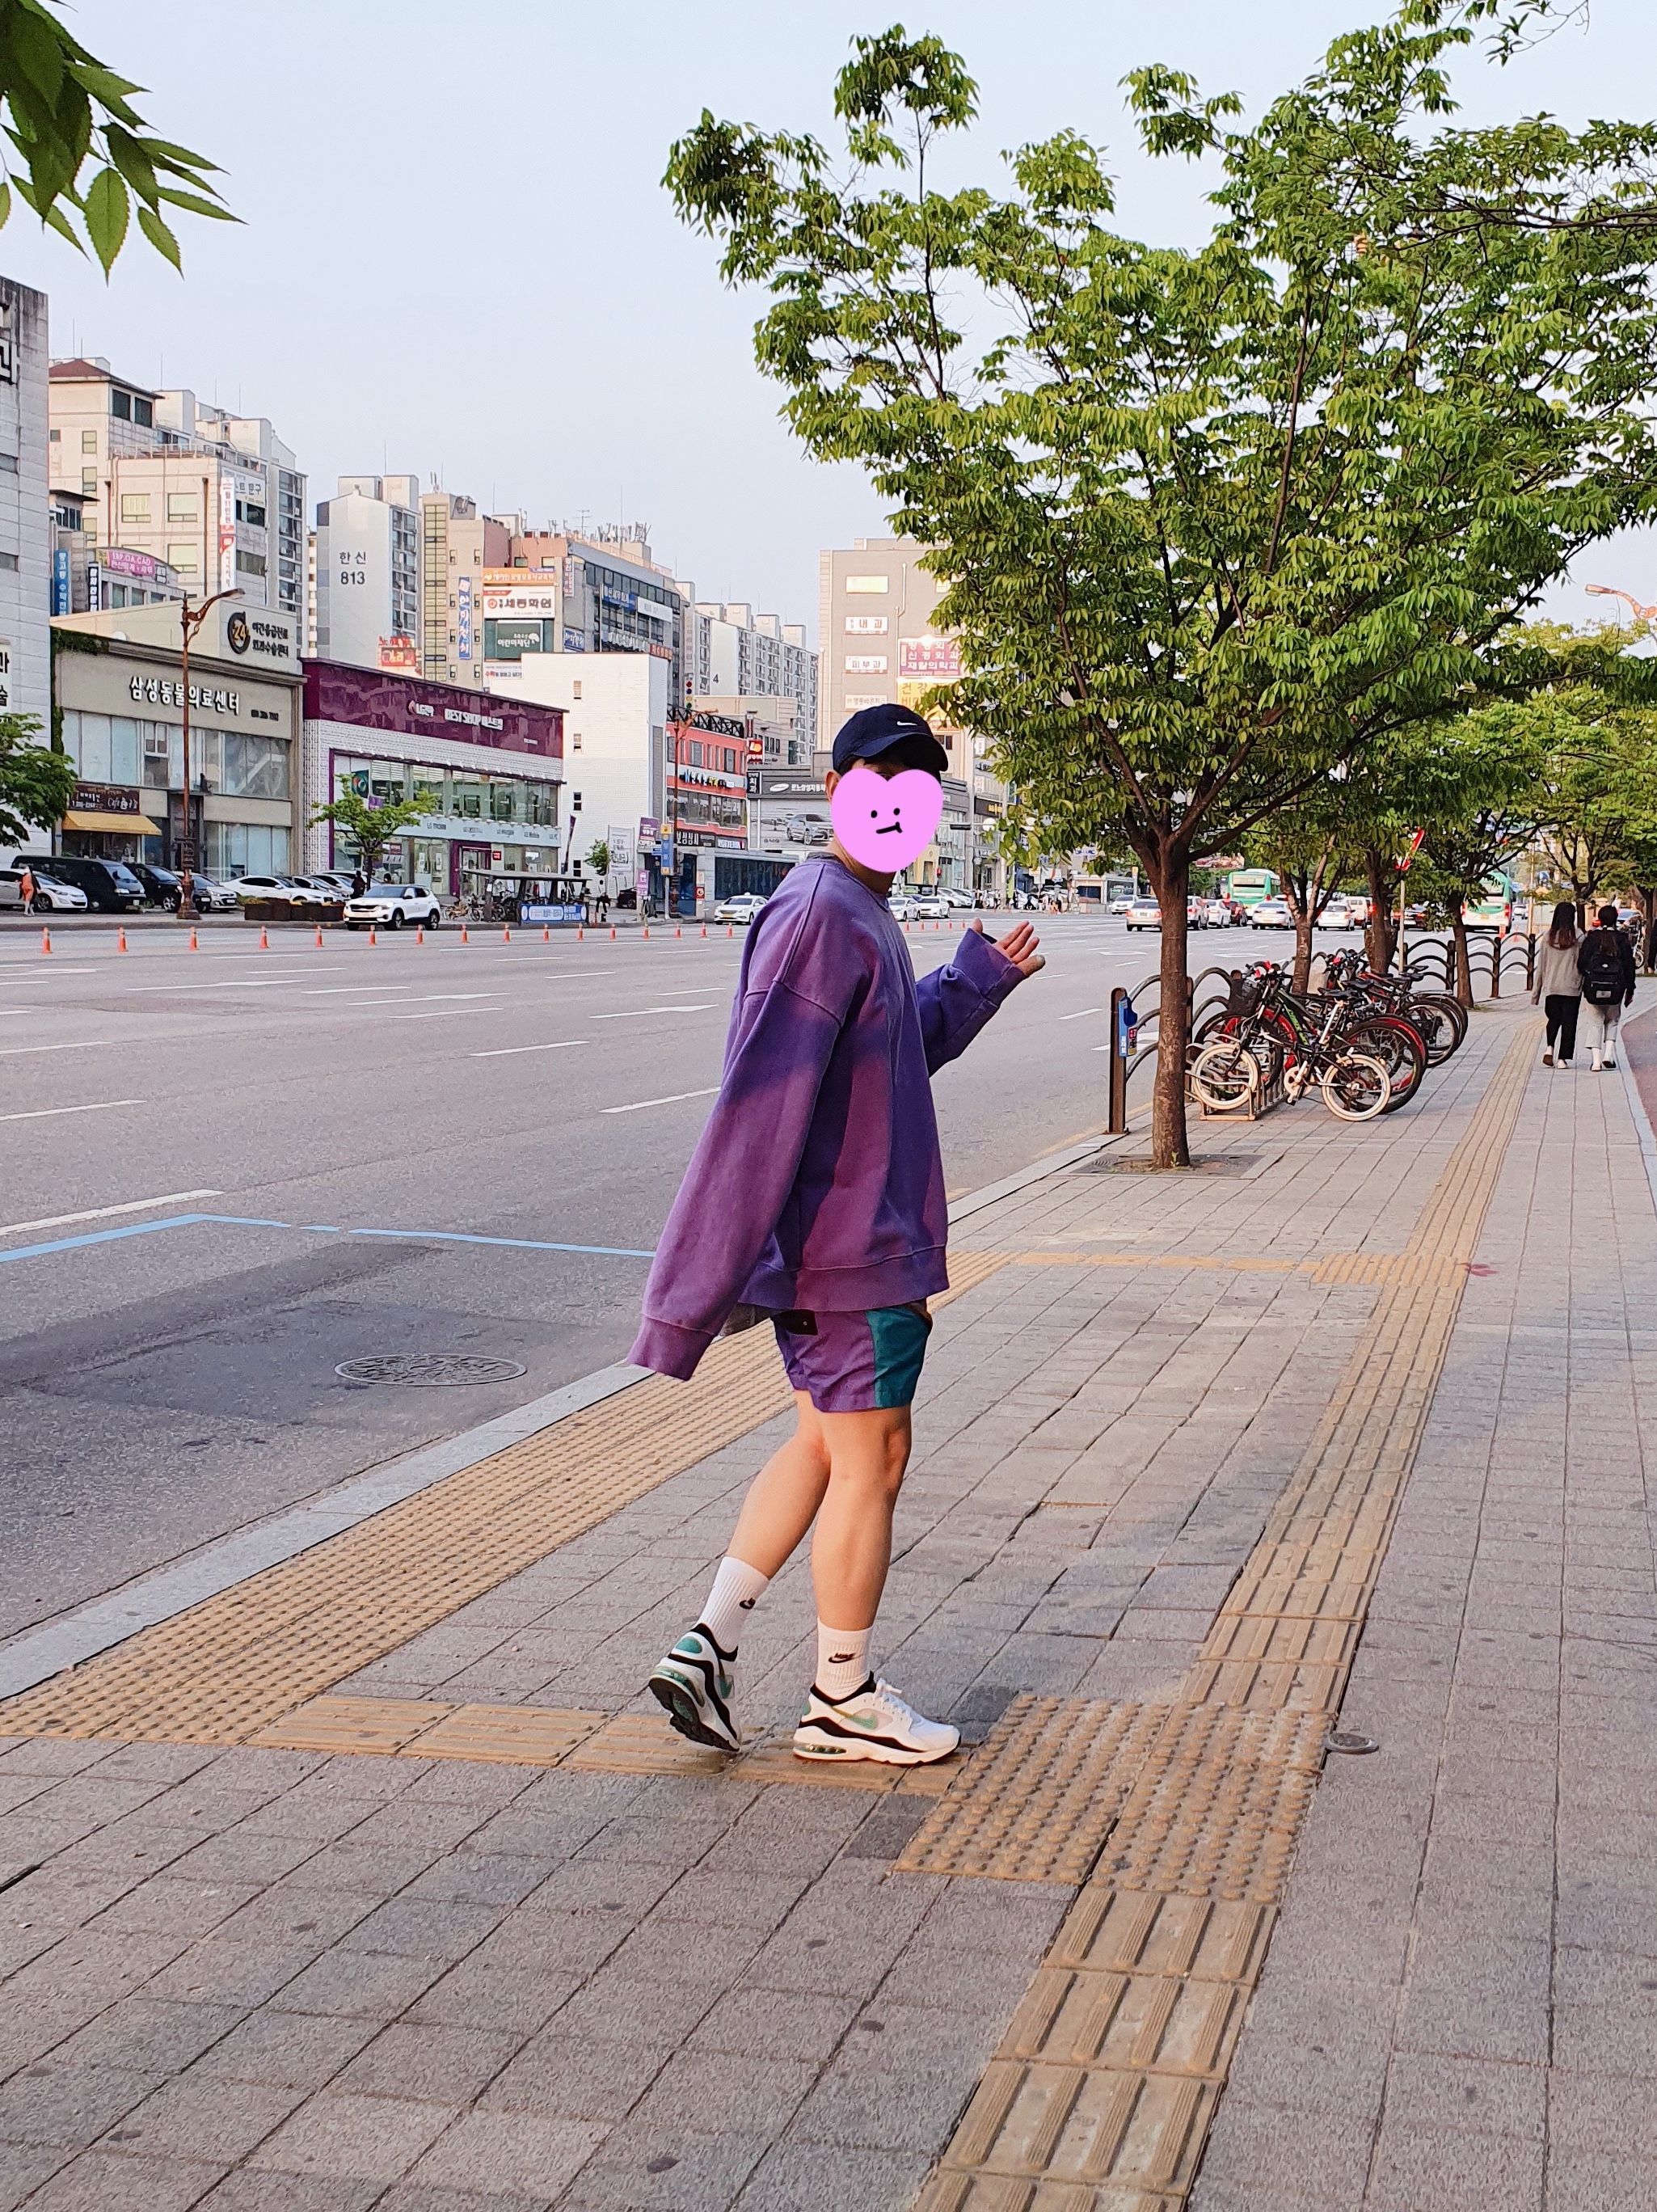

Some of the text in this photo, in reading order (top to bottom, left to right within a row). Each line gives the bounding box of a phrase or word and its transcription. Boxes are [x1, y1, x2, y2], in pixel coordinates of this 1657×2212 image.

[339, 551, 366, 564] 한신
[340, 571, 365, 585] 813
[908, 661, 959, 670] 재활의학과
[713, 674, 719, 683] 4
[130, 676, 240, 716] 삼성동물의료센터
[445, 708, 462, 723] BEST
[462, 712, 482, 726] SHOP
